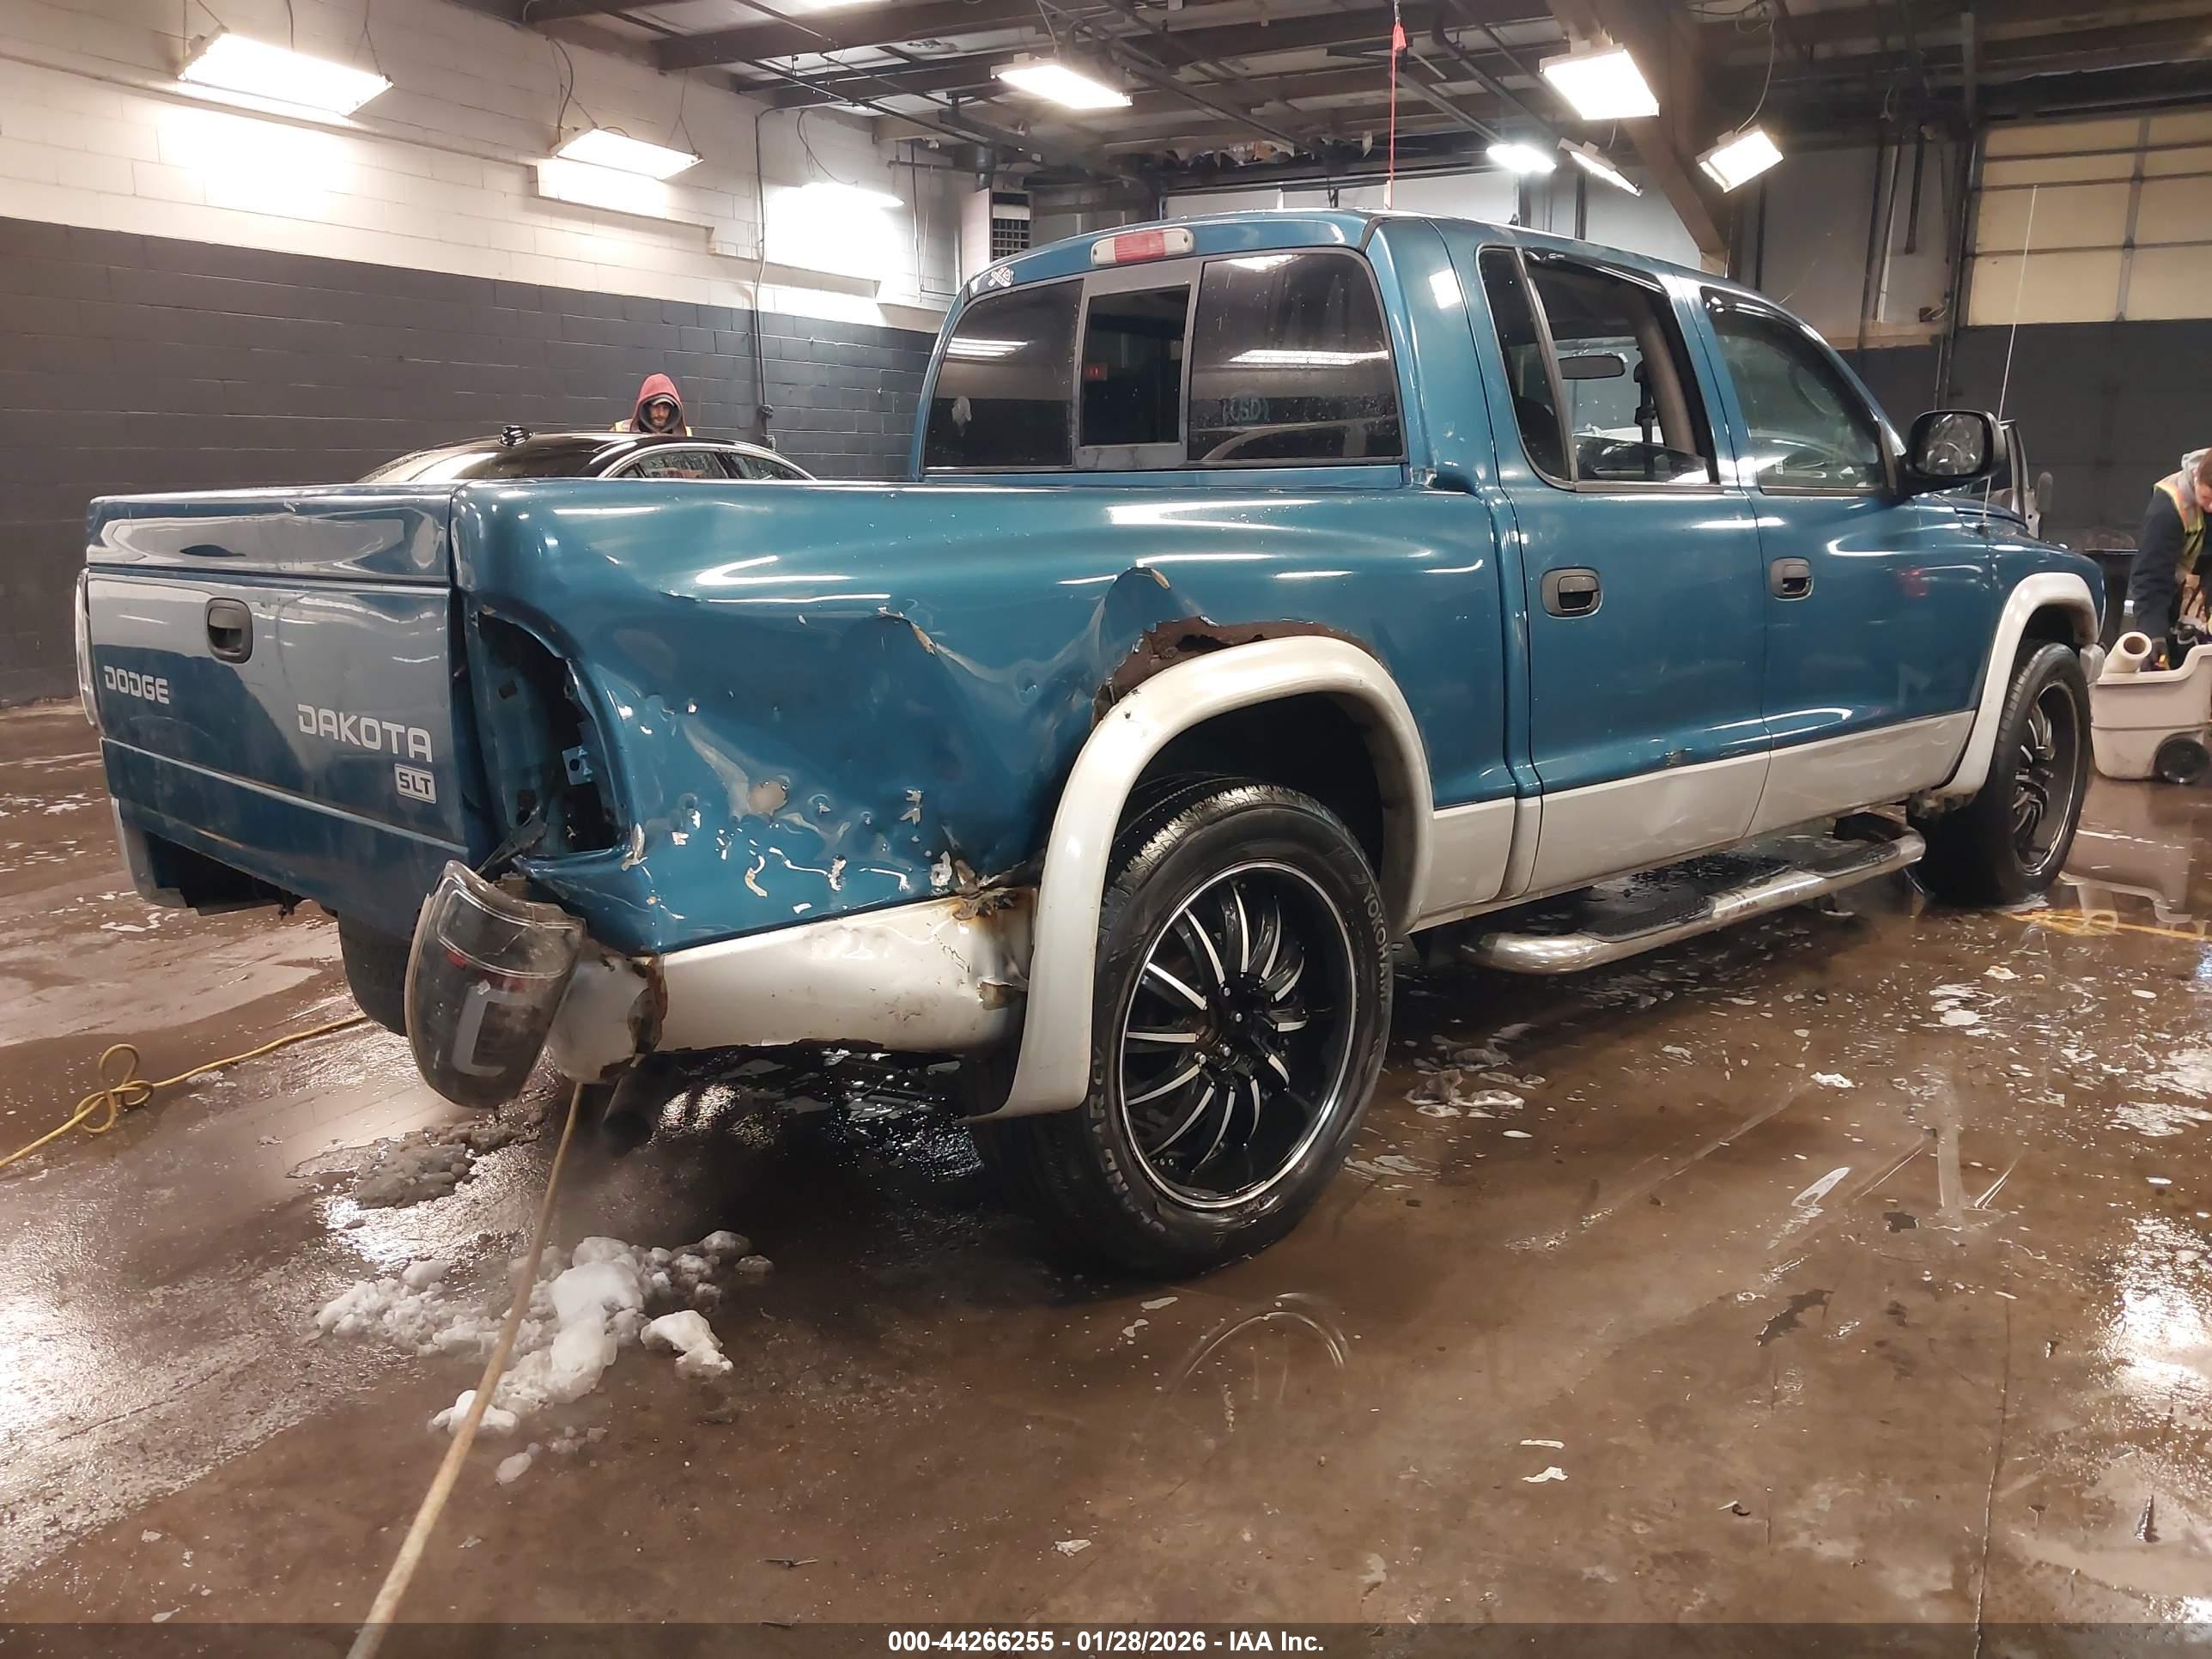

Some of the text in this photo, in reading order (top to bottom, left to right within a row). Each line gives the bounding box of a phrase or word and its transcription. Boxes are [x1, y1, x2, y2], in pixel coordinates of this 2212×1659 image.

[104, 665, 170, 705] DODGE
[297, 703, 433, 763] DAKOTA
[398, 771, 432, 795] SLT
